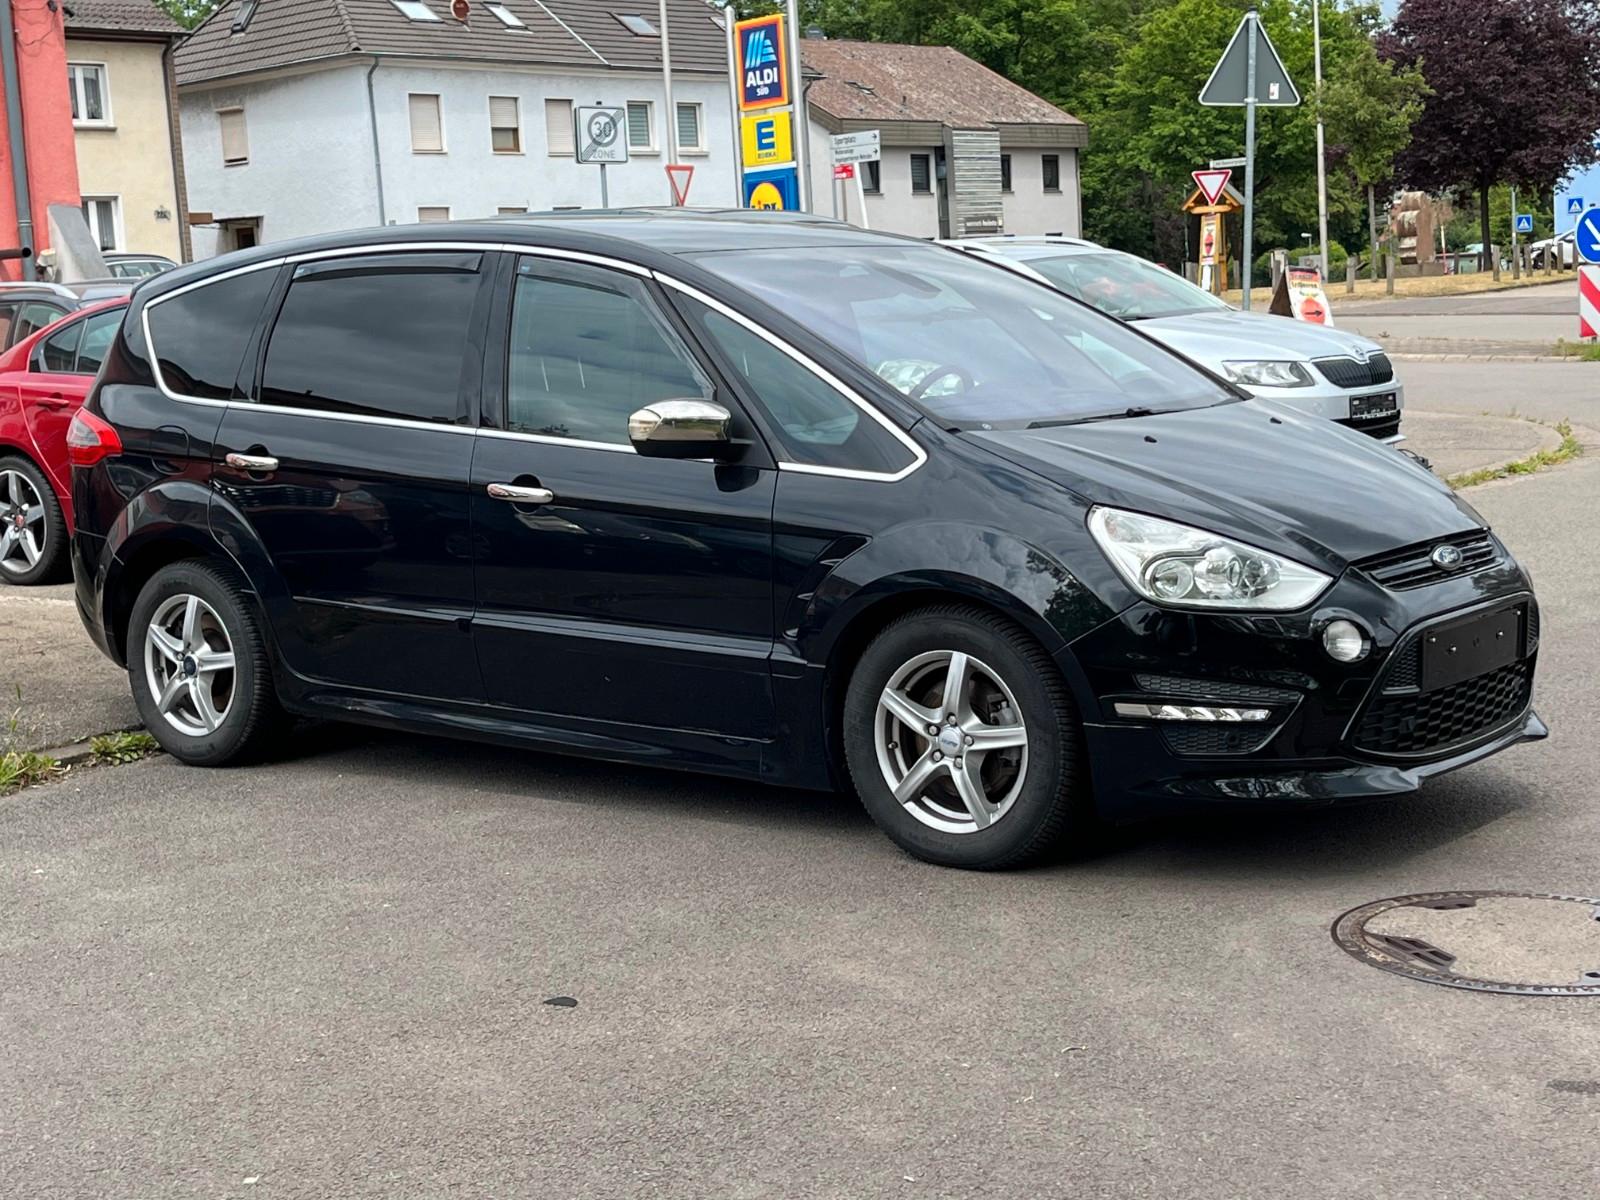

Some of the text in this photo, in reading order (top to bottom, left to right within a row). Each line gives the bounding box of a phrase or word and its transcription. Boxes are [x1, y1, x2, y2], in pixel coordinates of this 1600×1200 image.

[746, 67, 778, 88] ALDI
[594, 121, 612, 137] 30
[756, 120, 775, 150] E
[592, 149, 616, 159] ZONE
